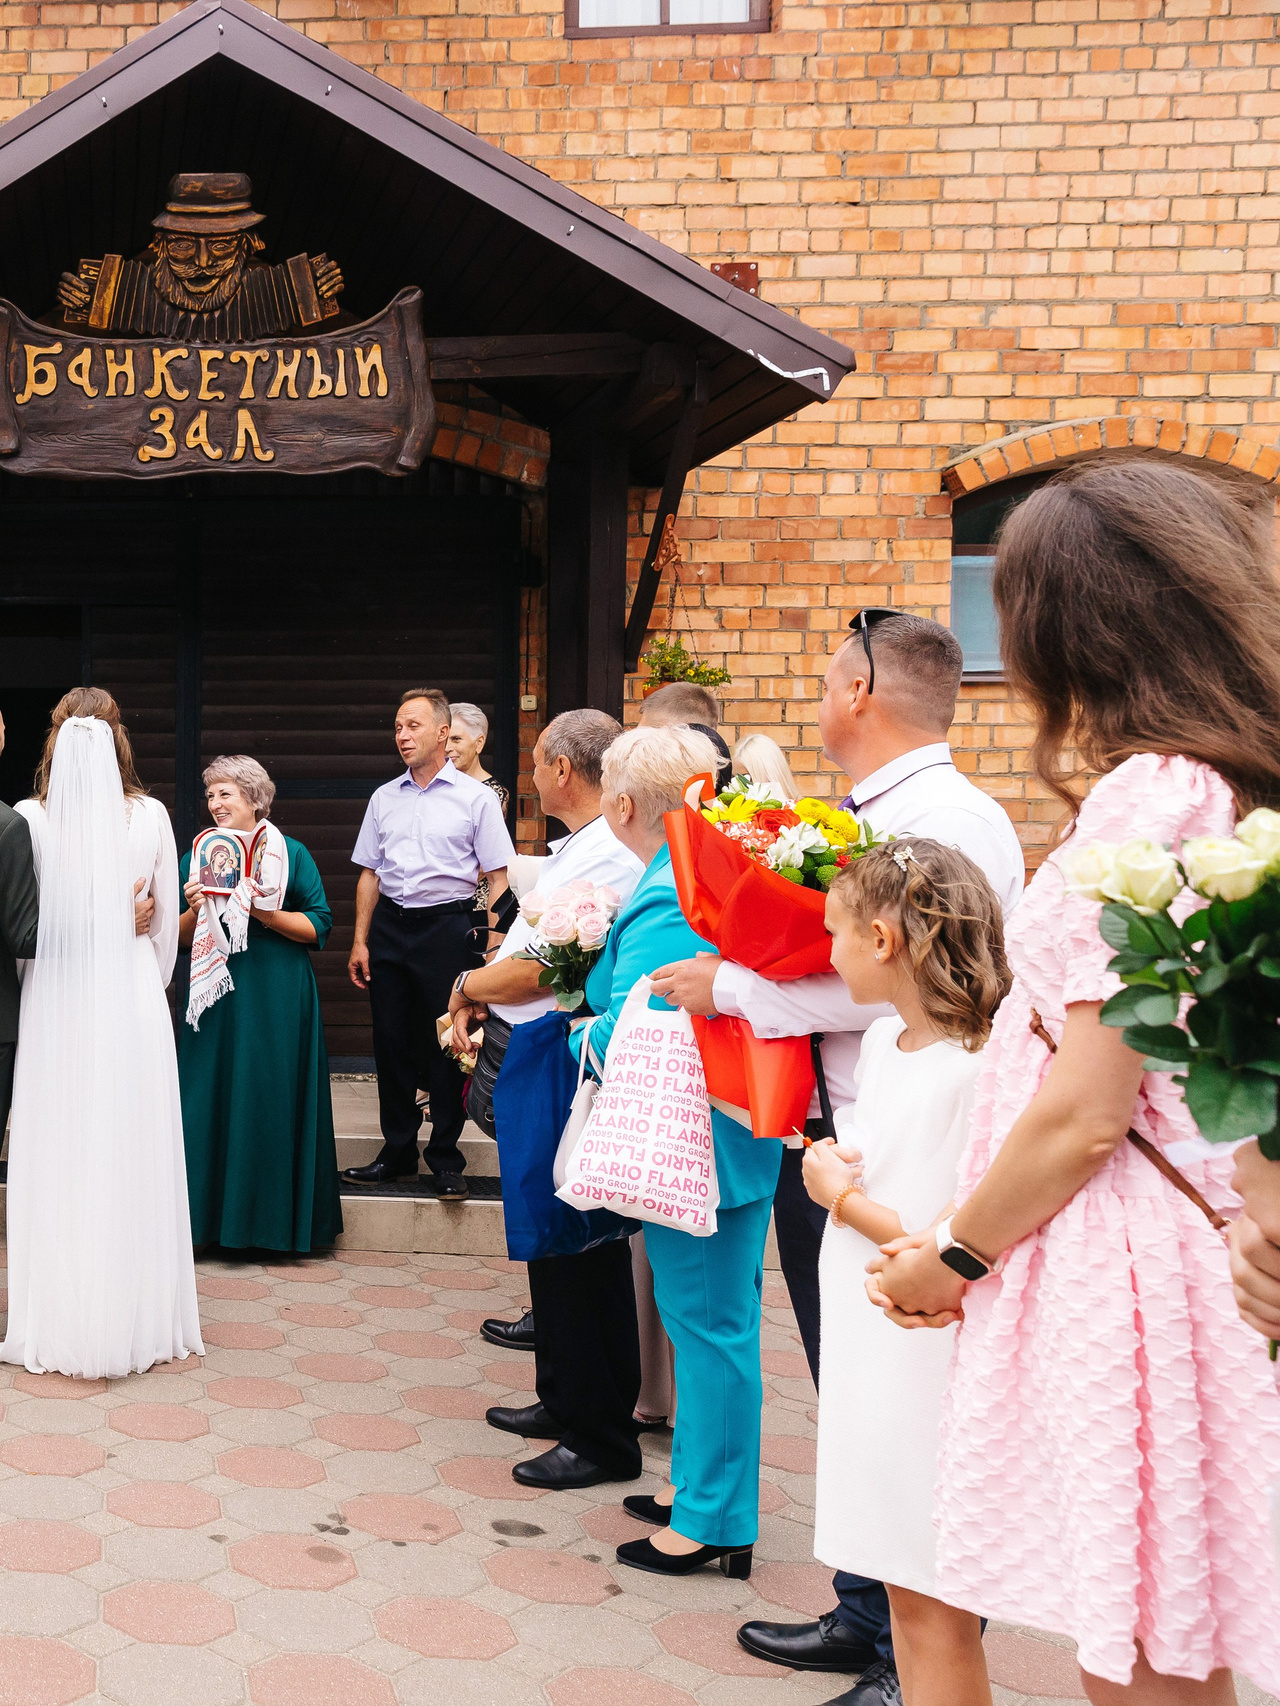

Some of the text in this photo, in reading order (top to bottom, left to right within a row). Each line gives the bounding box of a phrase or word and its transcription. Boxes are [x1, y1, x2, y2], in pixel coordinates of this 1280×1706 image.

[631, 1043, 662, 1054] GROUP
[623, 1087, 655, 1099] GROUP
[661, 1094, 692, 1106] GROUP
[595, 1096, 711, 1132] FLARIO FLARIO
[590, 1113, 711, 1150] FLARIO FLARIO
[615, 1132, 647, 1144] GROUP
[654, 1141, 686, 1153] GROUP
[583, 1139, 710, 1179] FLARIO FLARIO
[580, 1158, 709, 1198] FLARIO FLARIO
[607, 1179, 640, 1192] GROUP
[645, 1187, 677, 1201] GROUP
[571, 1182, 707, 1226] FLARIO FLARIO
